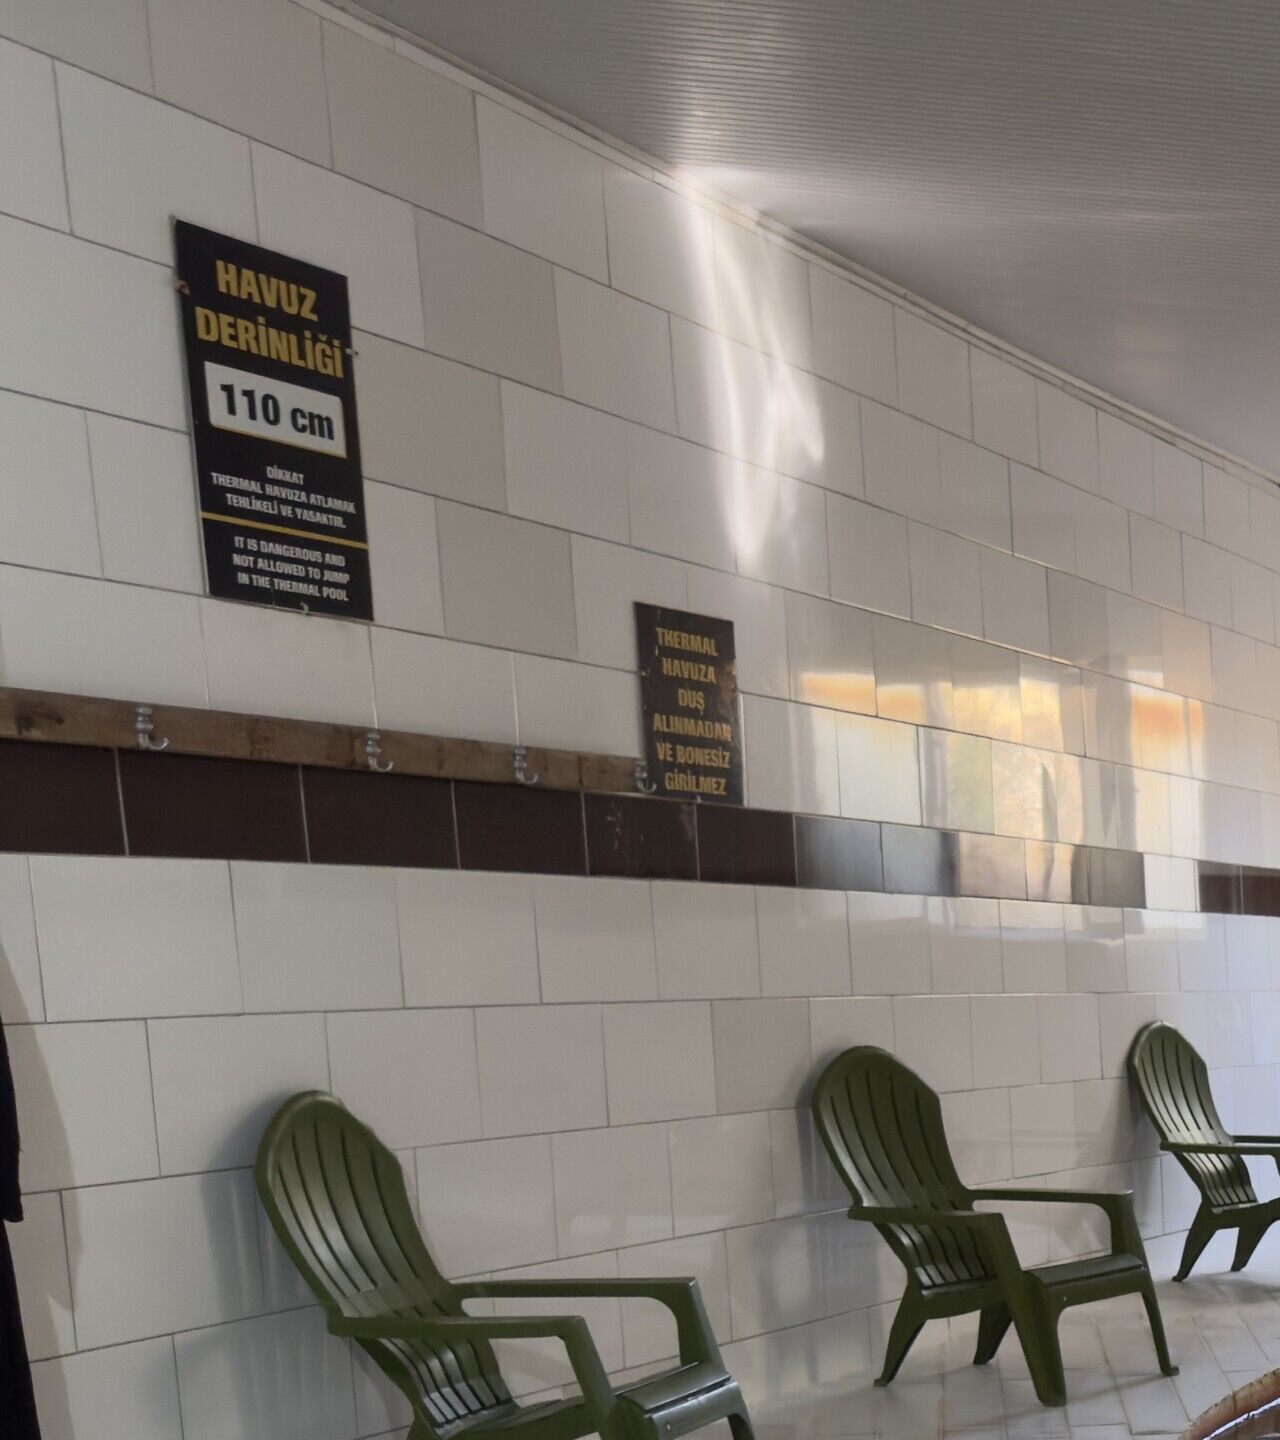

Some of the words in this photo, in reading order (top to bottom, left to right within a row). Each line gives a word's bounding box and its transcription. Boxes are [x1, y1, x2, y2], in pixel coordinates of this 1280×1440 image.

[215, 259, 318, 322] HAVUZ
[195, 306, 344, 379] DERİNLİĞİ
[220, 384, 281, 426] 110
[291, 407, 335, 441] cm
[266, 465, 304, 485] DİKKAT
[210, 472, 264, 494] THERMAL
[265, 483, 308, 504] HAVUZA
[310, 494, 356, 514] ATLAMAK
[225, 493, 278, 515] TEHLİKELİ
[280, 504, 294, 518] VE
[234, 536, 244, 548] IT
[247, 538, 258, 551] IS
[260, 541, 323, 563] DANGEROUS
[324, 553, 346, 567] AND
[232, 553, 255, 568] NOT
[257, 558, 306, 577] ALLOWED
[307, 567, 321, 580] TO
[323, 569, 350, 585] JUMP
[237, 572, 250, 585] IN
[251, 574, 272, 589] THE
[273, 578, 321, 597] THERMAL
[322, 586, 350, 602] POOL
[656, 627, 719, 657] THERMAL
[662, 657, 717, 684] HAVUZA
[677, 687, 705, 716] DUŞ
[653, 713, 732, 743] ALINMADAN
[656, 742, 674, 762] VE
[676, 745, 731, 769] BONESİZ
[664, 768, 728, 796] GİRİLMEZ
